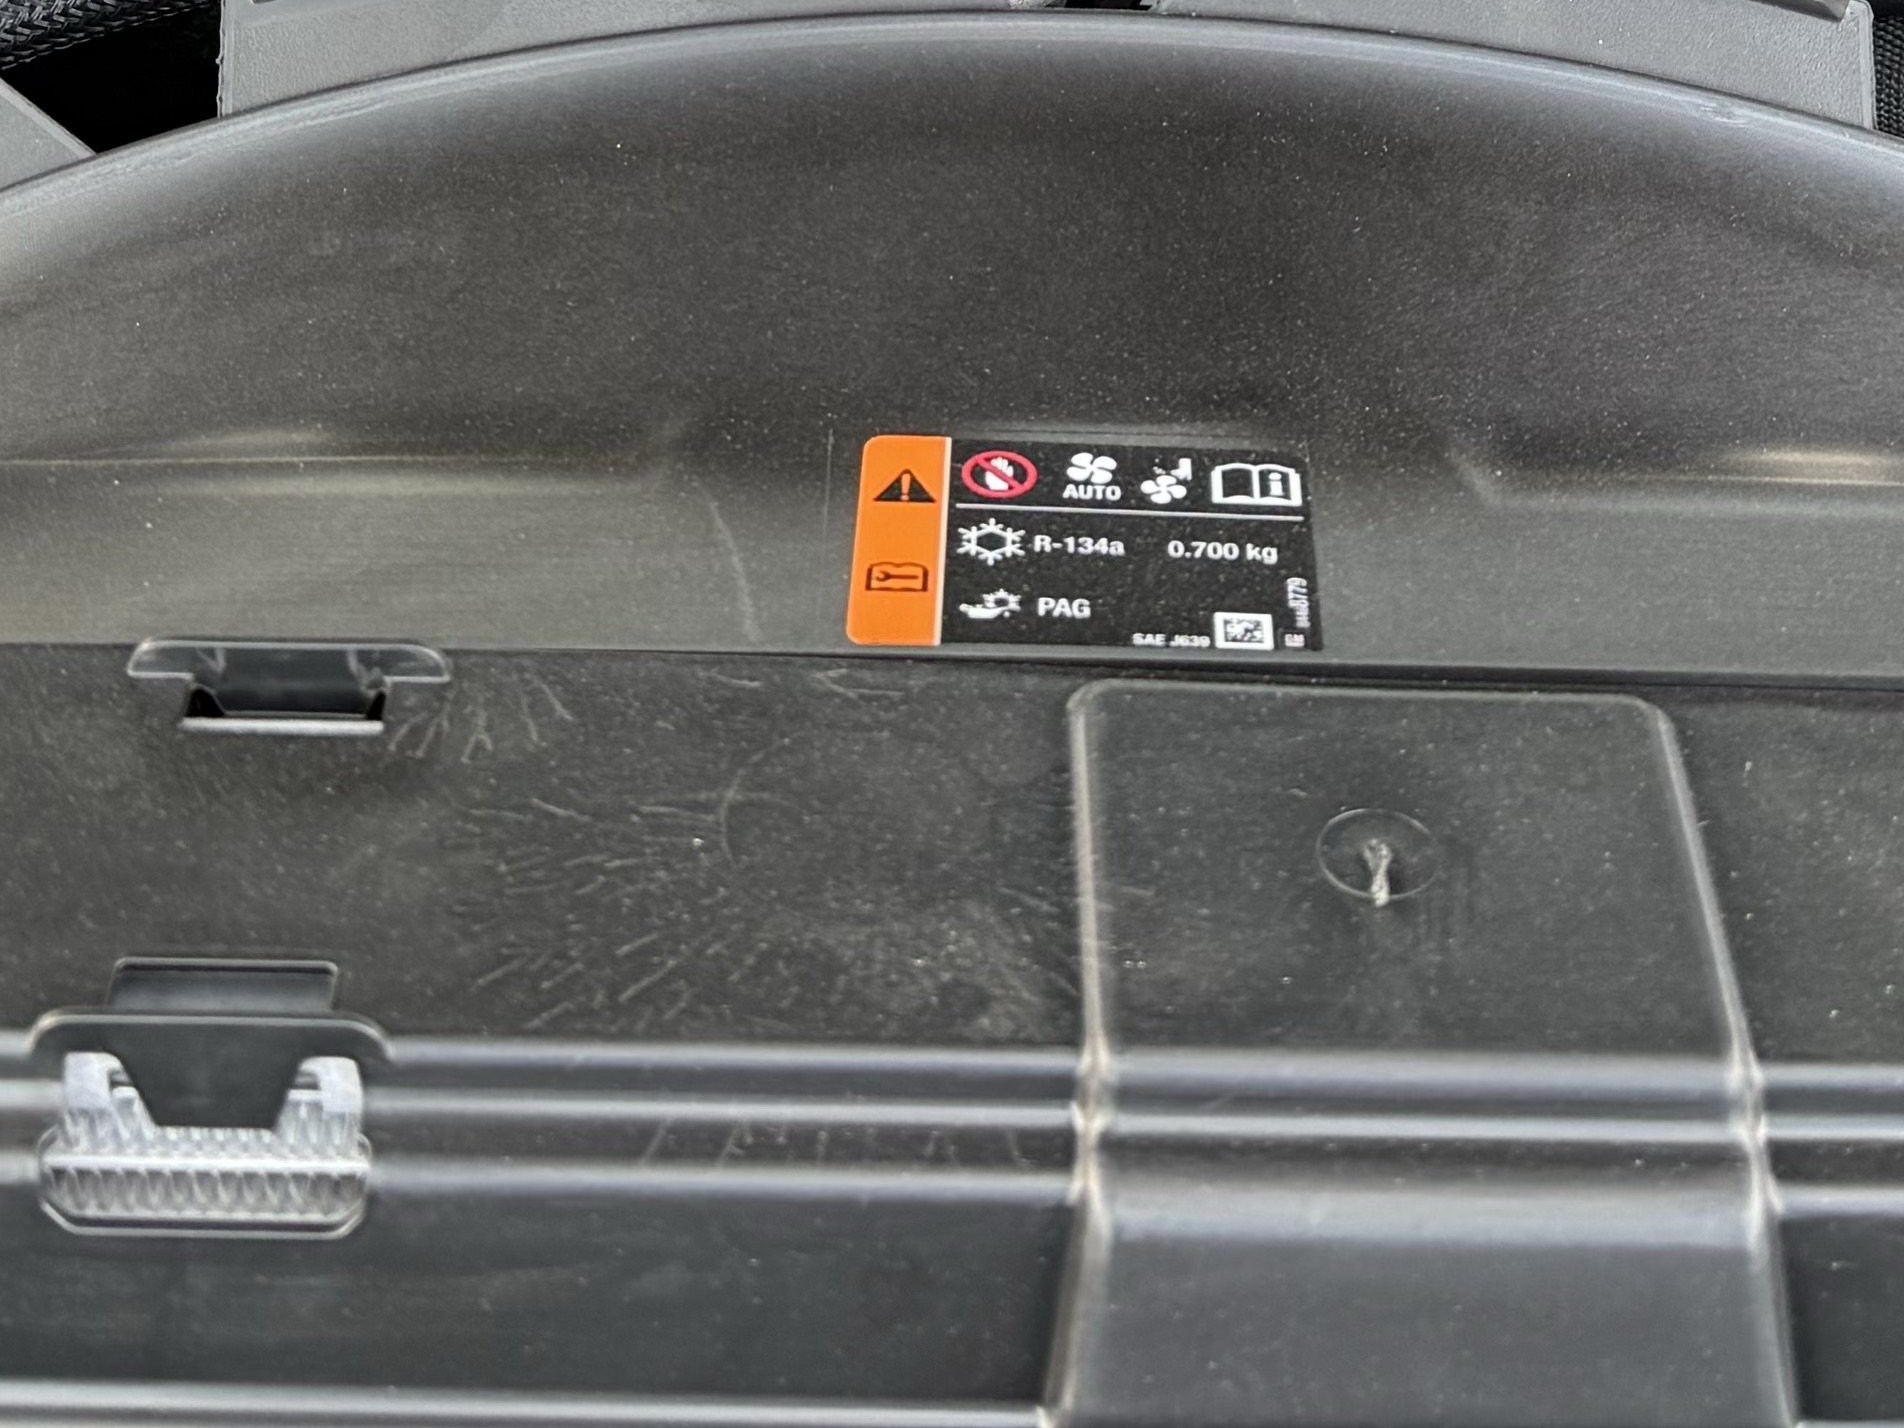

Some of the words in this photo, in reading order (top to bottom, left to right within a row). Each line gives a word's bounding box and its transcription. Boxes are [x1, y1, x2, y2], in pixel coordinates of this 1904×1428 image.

[1062, 483, 1122, 501] AUTO
[1033, 534, 1126, 556] R-134a
[1168, 540, 1240, 560] 0.700
[1245, 542, 1278, 565] kg
[1037, 596, 1092, 619] PAG
[1132, 633, 1167, 646] SAE
